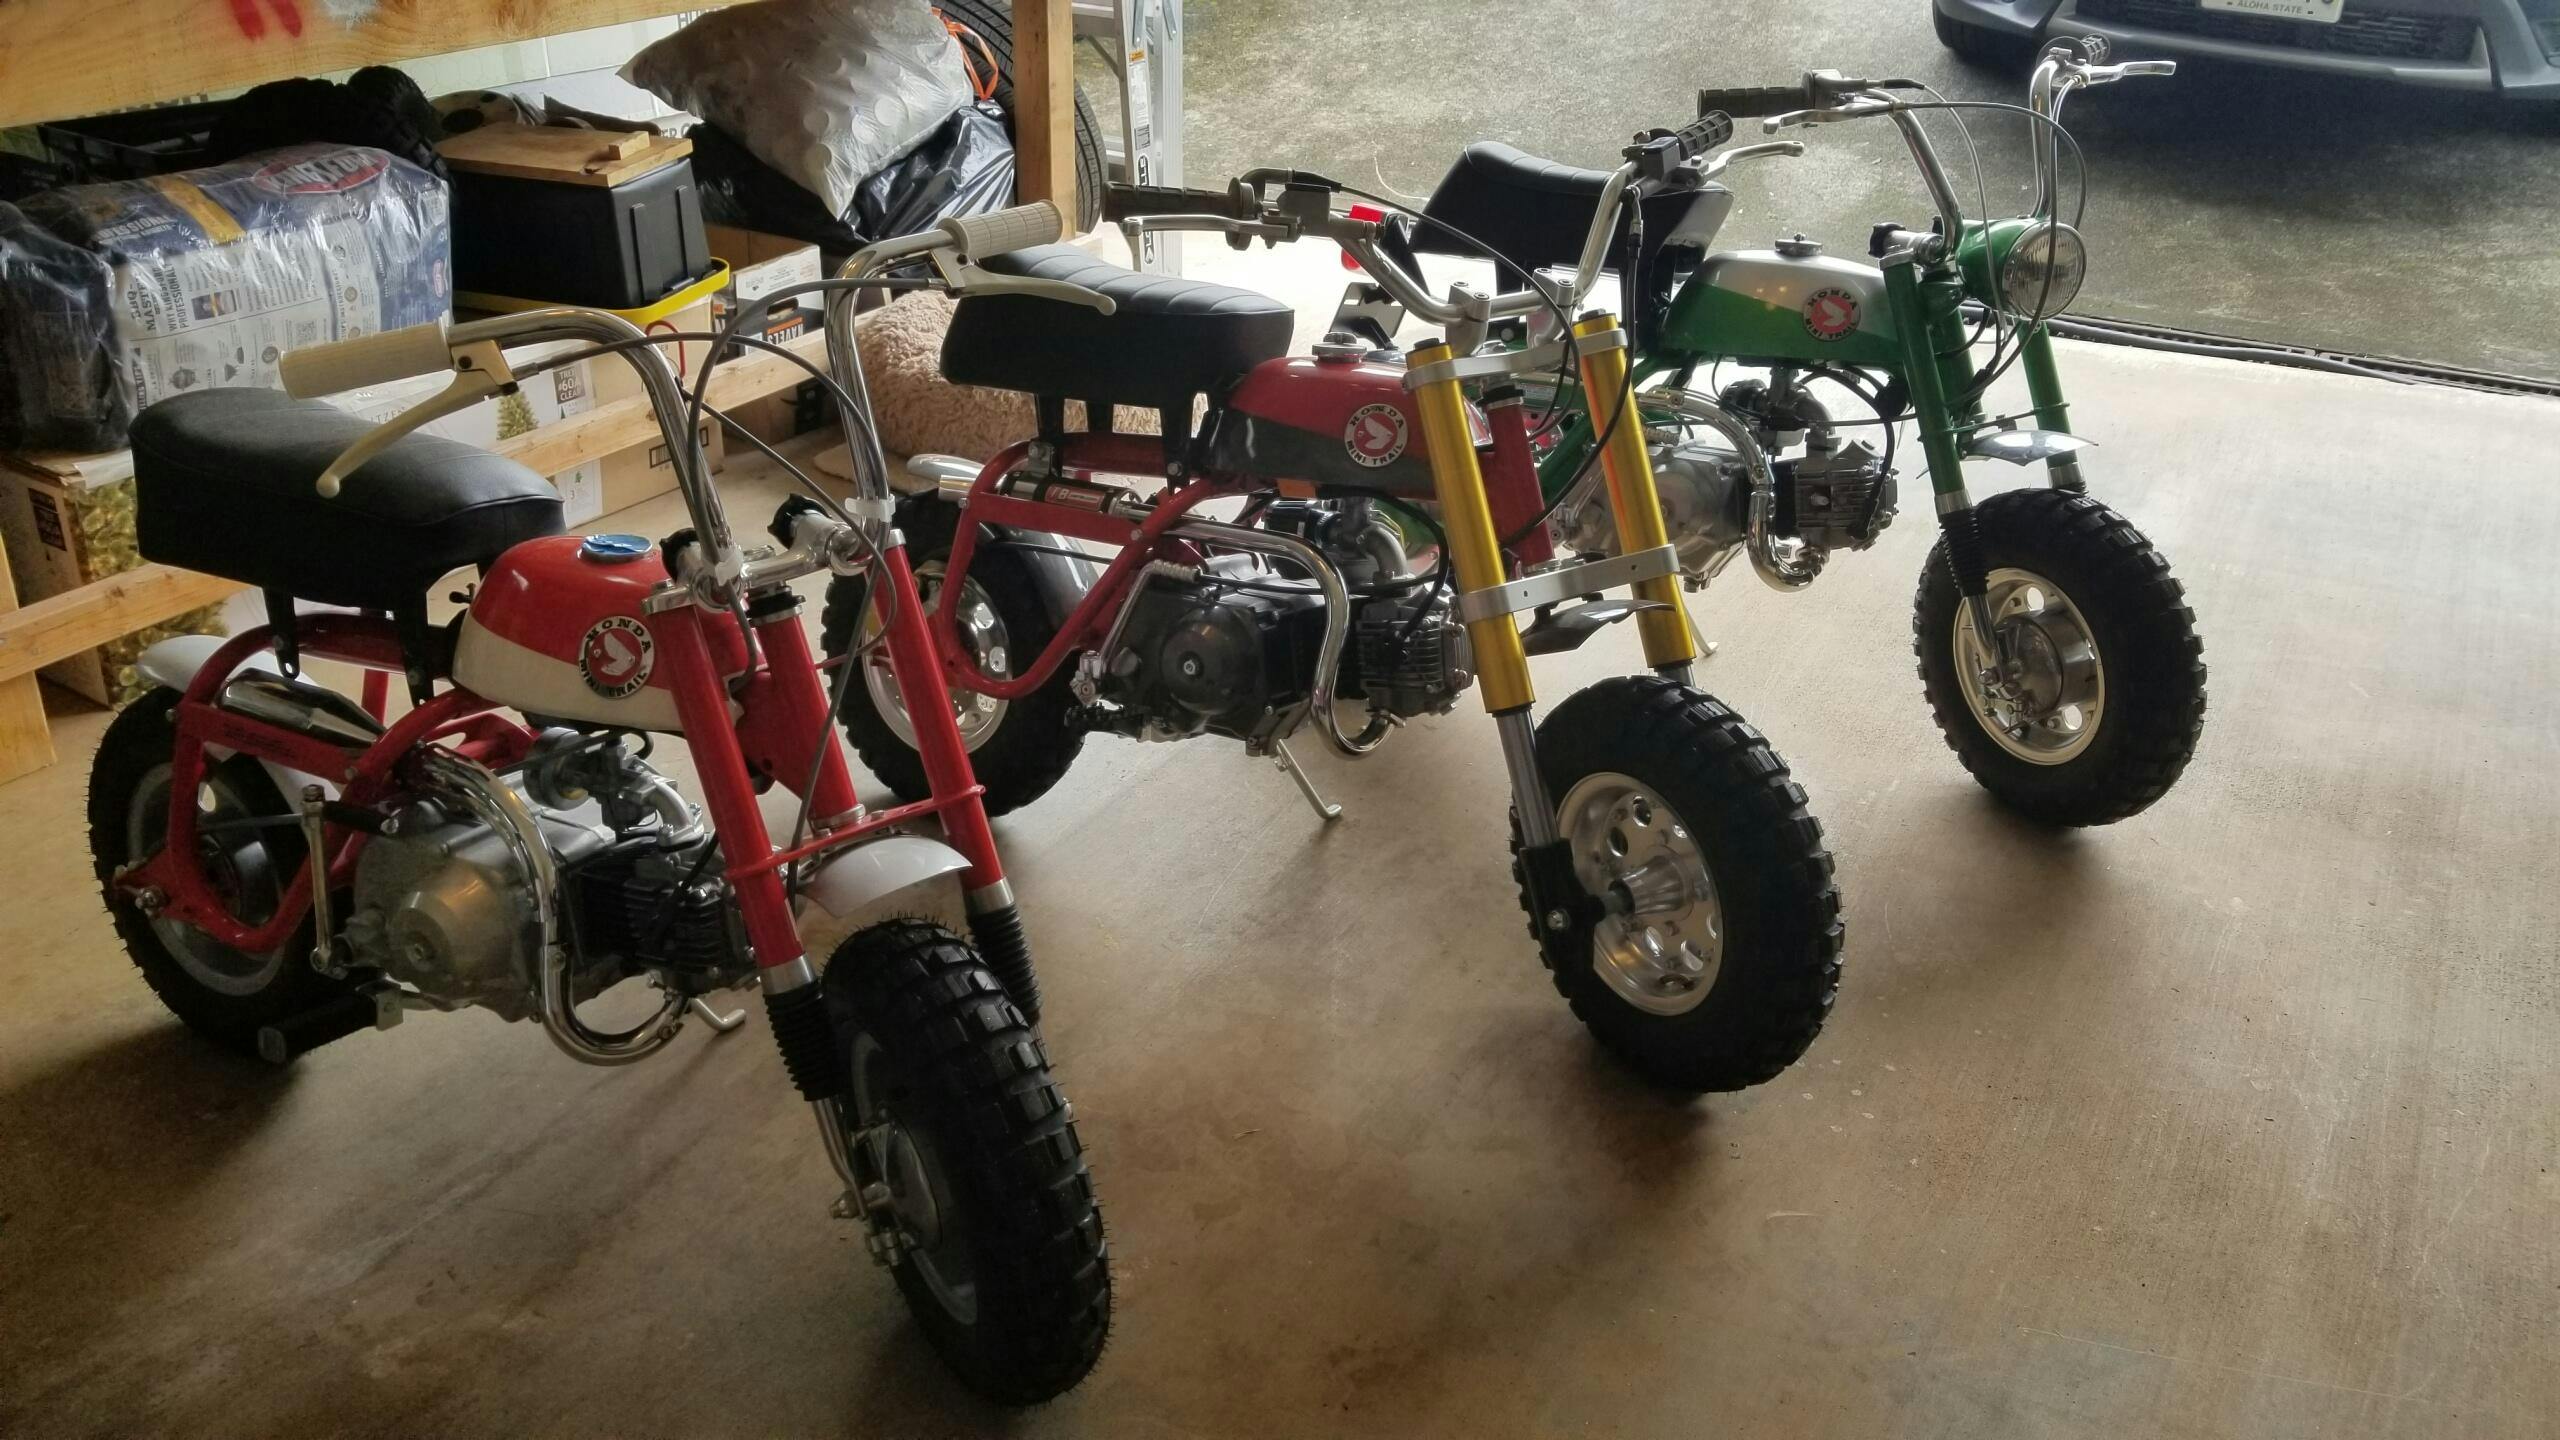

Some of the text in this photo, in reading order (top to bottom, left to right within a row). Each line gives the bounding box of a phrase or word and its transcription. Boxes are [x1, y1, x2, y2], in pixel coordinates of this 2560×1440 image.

[2237, 1, 2302, 14] ALOHA STATE
[1350, 405, 1404, 429] HONDA
[1347, 440, 1404, 465] MINI TRAIL
[586, 618, 652, 654] HONDA
[580, 659, 649, 697] MINI TRAIL
